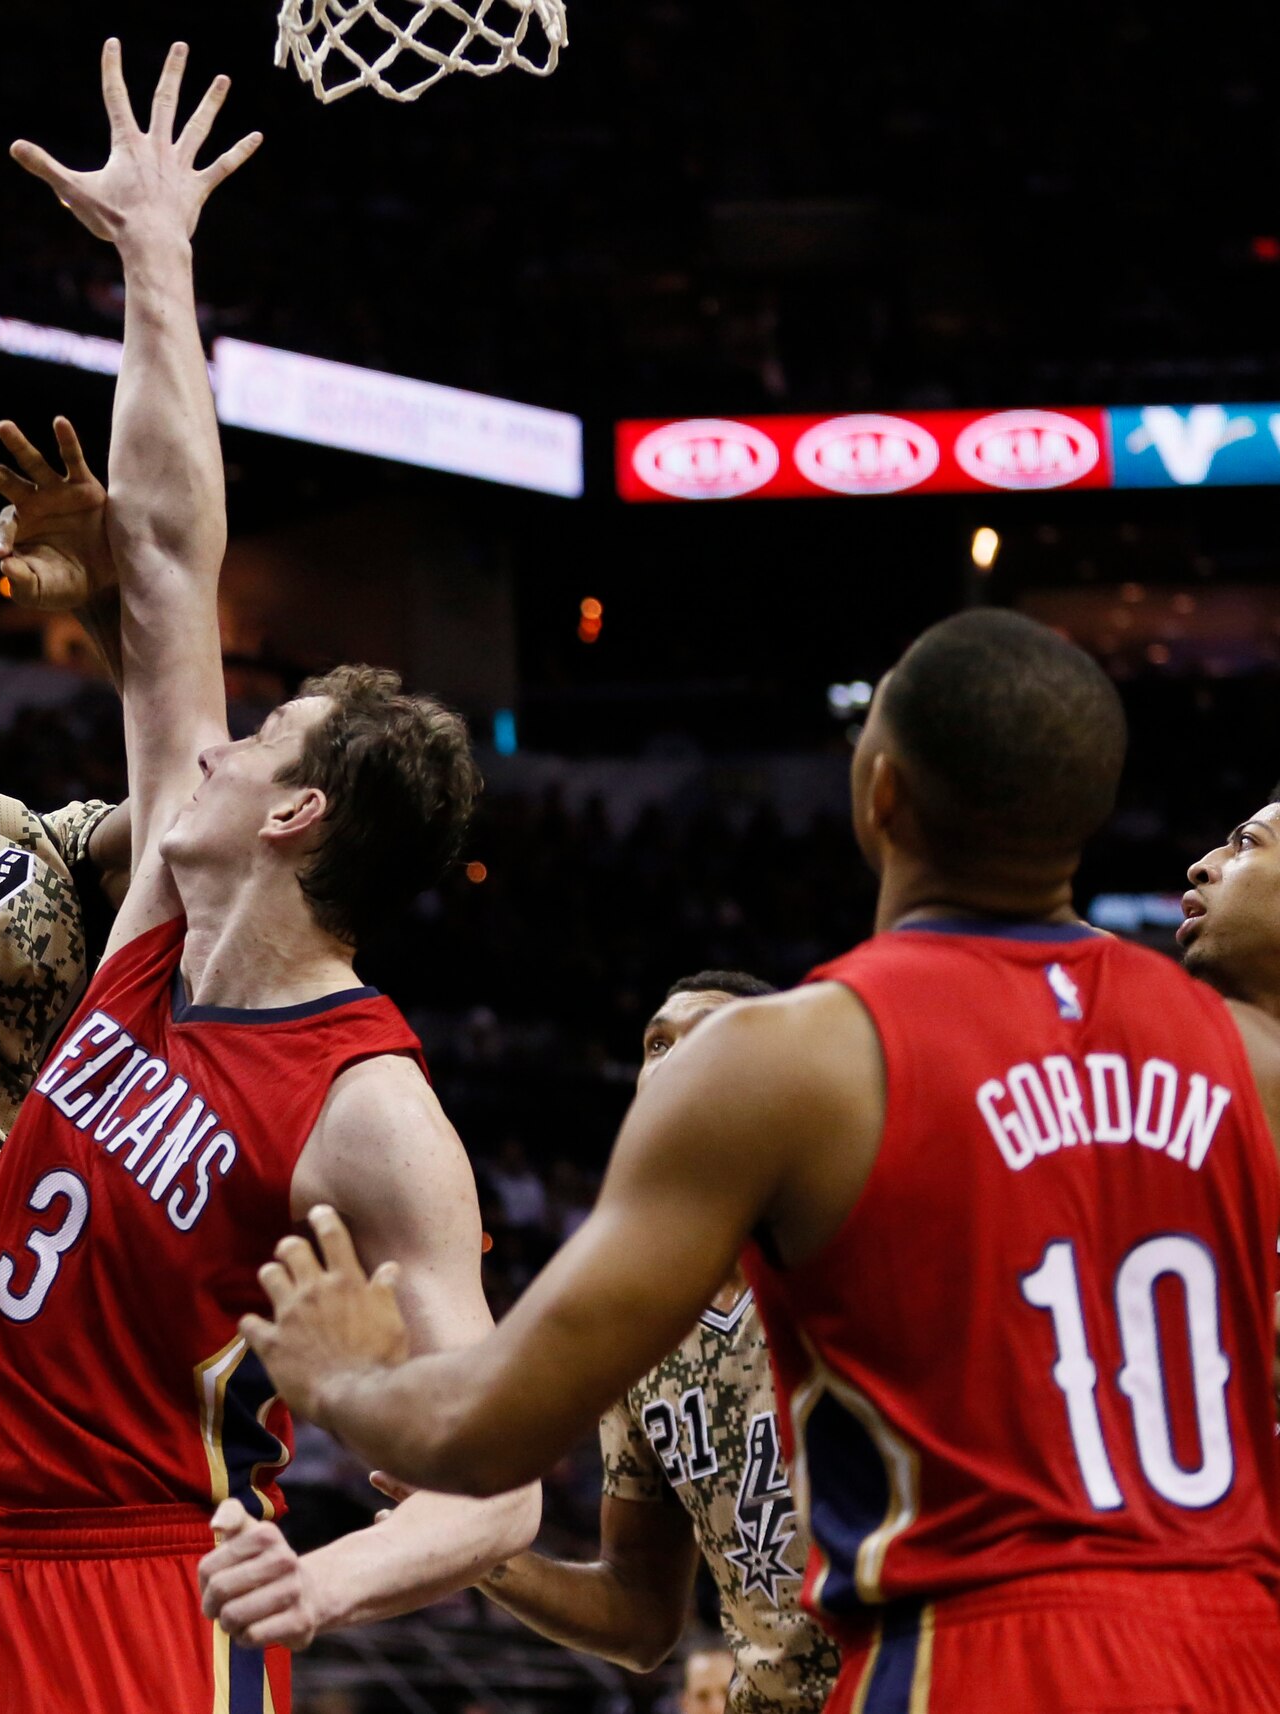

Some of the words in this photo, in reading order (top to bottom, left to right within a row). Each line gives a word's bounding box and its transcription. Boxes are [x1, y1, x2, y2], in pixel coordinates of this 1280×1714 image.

[976, 1053, 1232, 1173] GORDON
[1018, 1231, 1236, 1513] 10
[642, 1386, 719, 1488] 21
